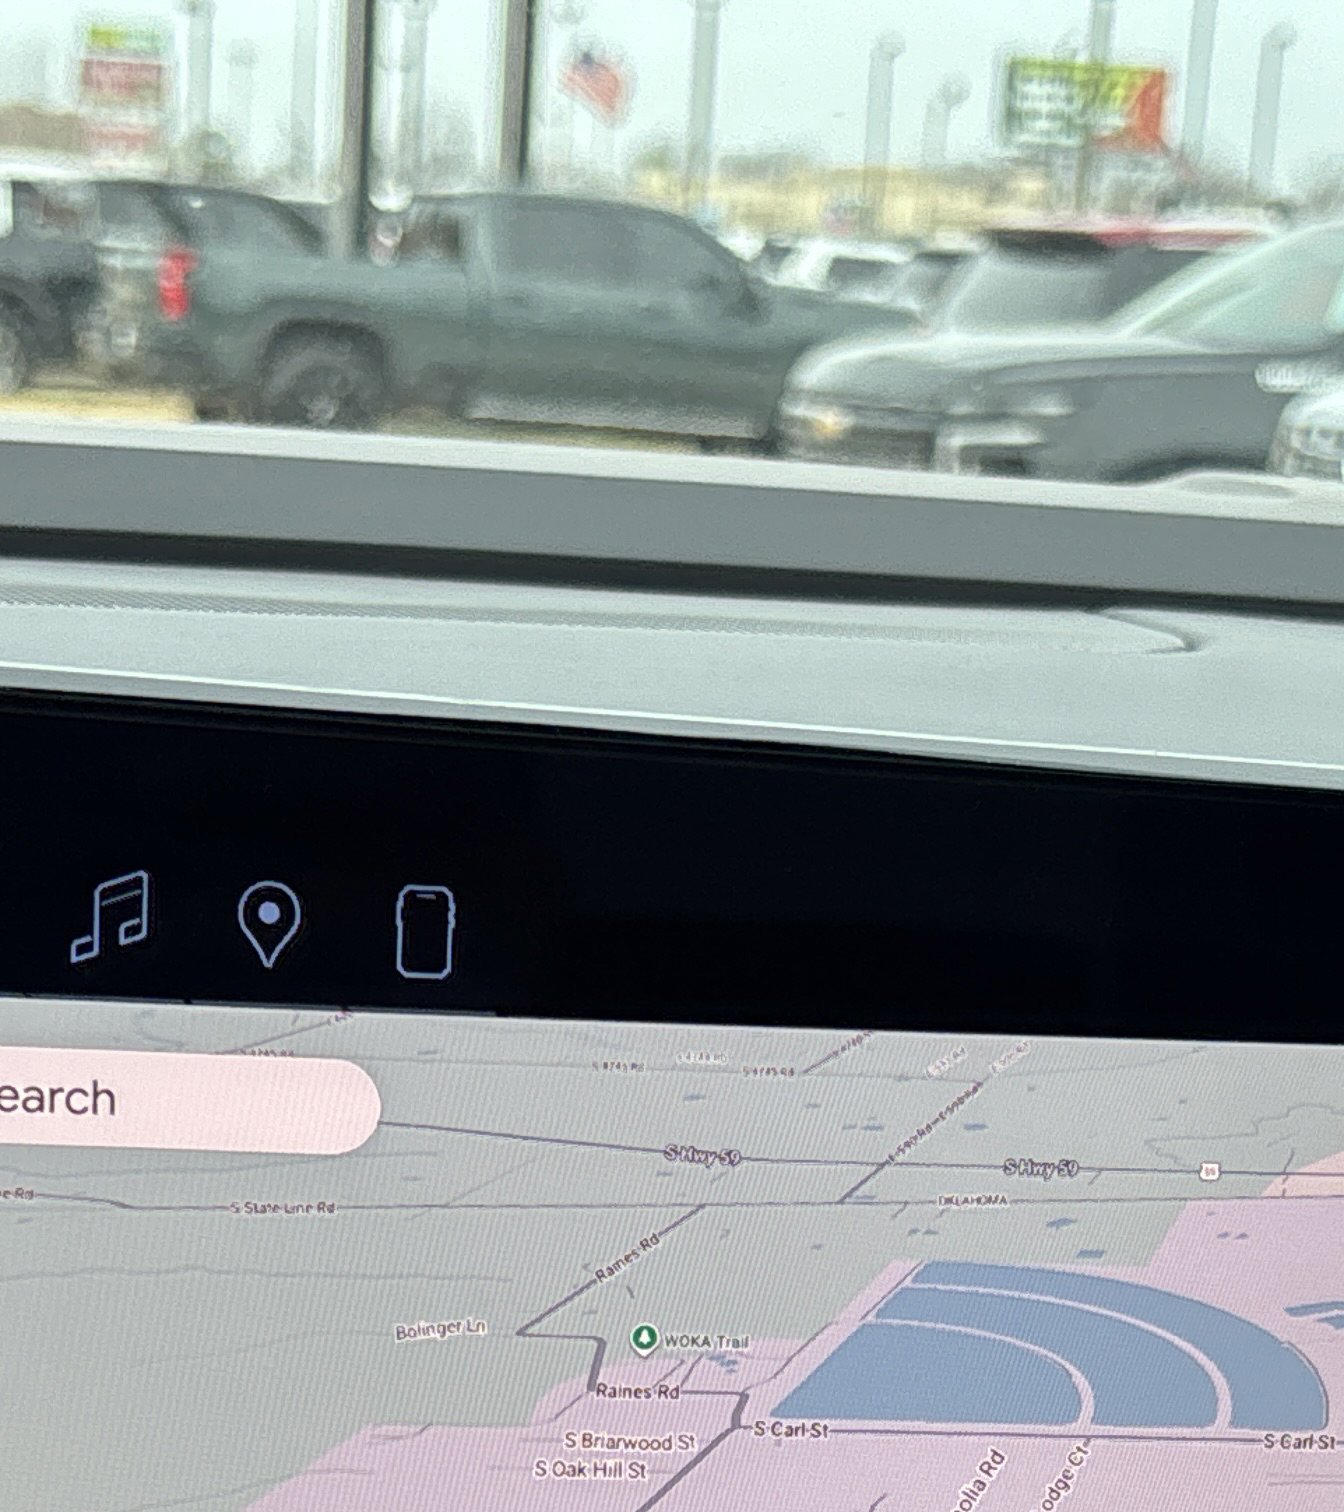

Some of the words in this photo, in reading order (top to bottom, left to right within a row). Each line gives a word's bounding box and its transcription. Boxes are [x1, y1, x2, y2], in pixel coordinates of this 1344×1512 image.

[665, 1145, 678, 1161] S
[681, 1146, 718, 1168] Hwy
[719, 1150, 741, 1166] 59
[230, 1202, 240, 1214] S
[244, 1201, 280, 1215] State
[317, 1202, 336, 1214] Rd
[466, 1319, 486, 1334] Ln
[665, 1335, 711, 1349] WOKA
[717, 1334, 749, 1349] Trail
[596, 1384, 652, 1399] Raines
[656, 1384, 680, 1399] Rd
[754, 1421, 766, 1436] S
[771, 1421, 805, 1437] Carl
[812, 1422, 829, 1438] St
[565, 1433, 576, 1449] S
[582, 1432, 672, 1451] Briarwood
[677, 1434, 695, 1450] St
[1068, 1445, 1089, 1470] Ct
[534, 1462, 547, 1478] S
[552, 1462, 587, 1478] Oak
[593, 1462, 623, 1479] Hill
[628, 1463, 647, 1479] St
